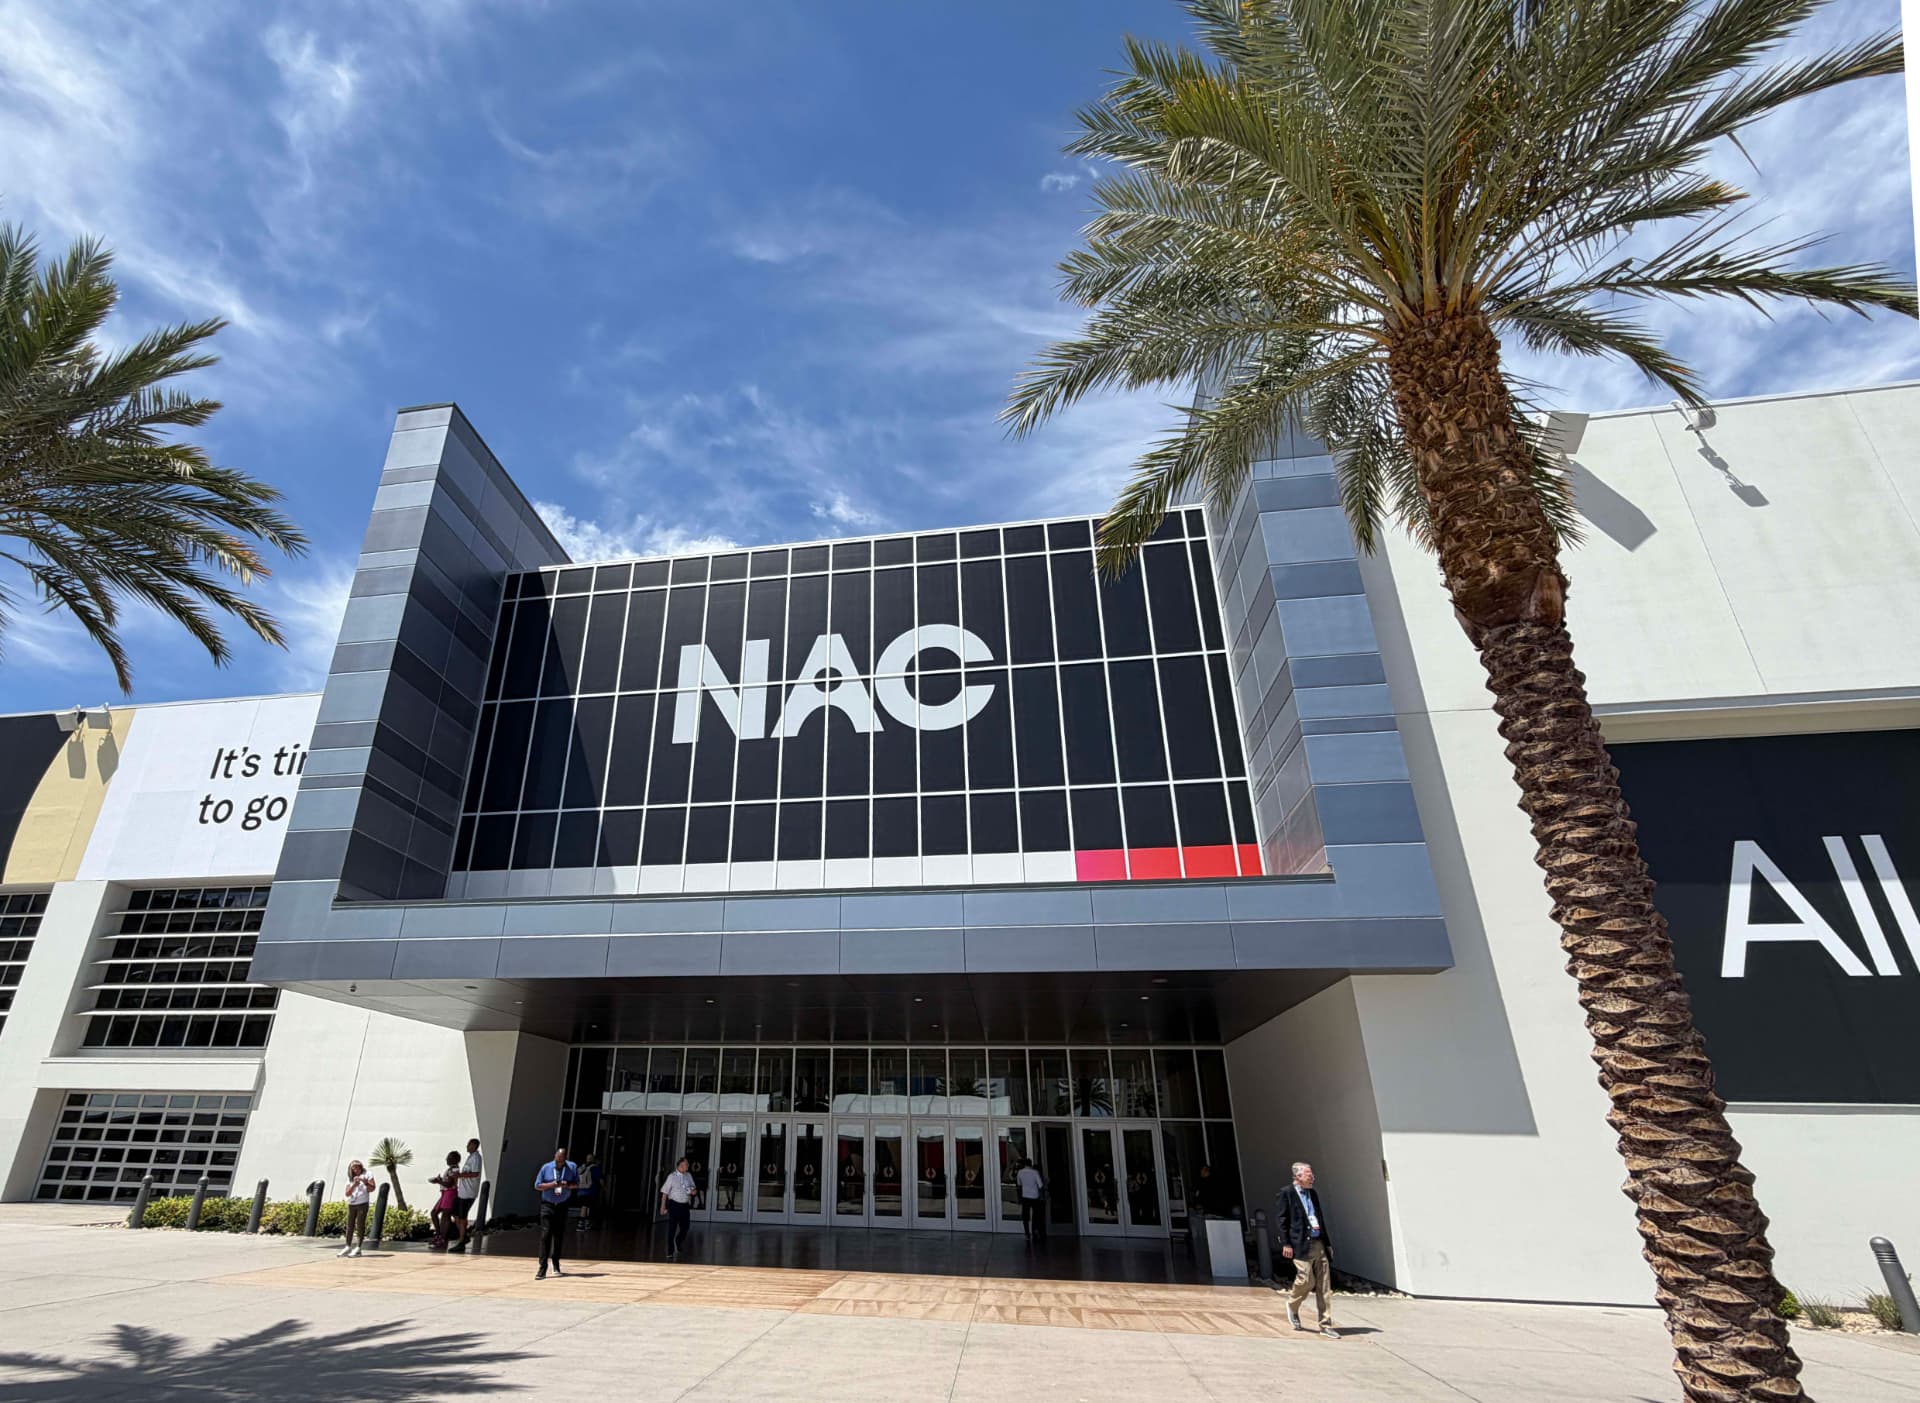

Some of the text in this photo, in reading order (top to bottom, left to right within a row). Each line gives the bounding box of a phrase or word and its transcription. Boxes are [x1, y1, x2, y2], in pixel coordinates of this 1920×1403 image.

[672, 624, 995, 744] NAC
[210, 746, 262, 779] It’s
[198, 793, 288, 831] to go
